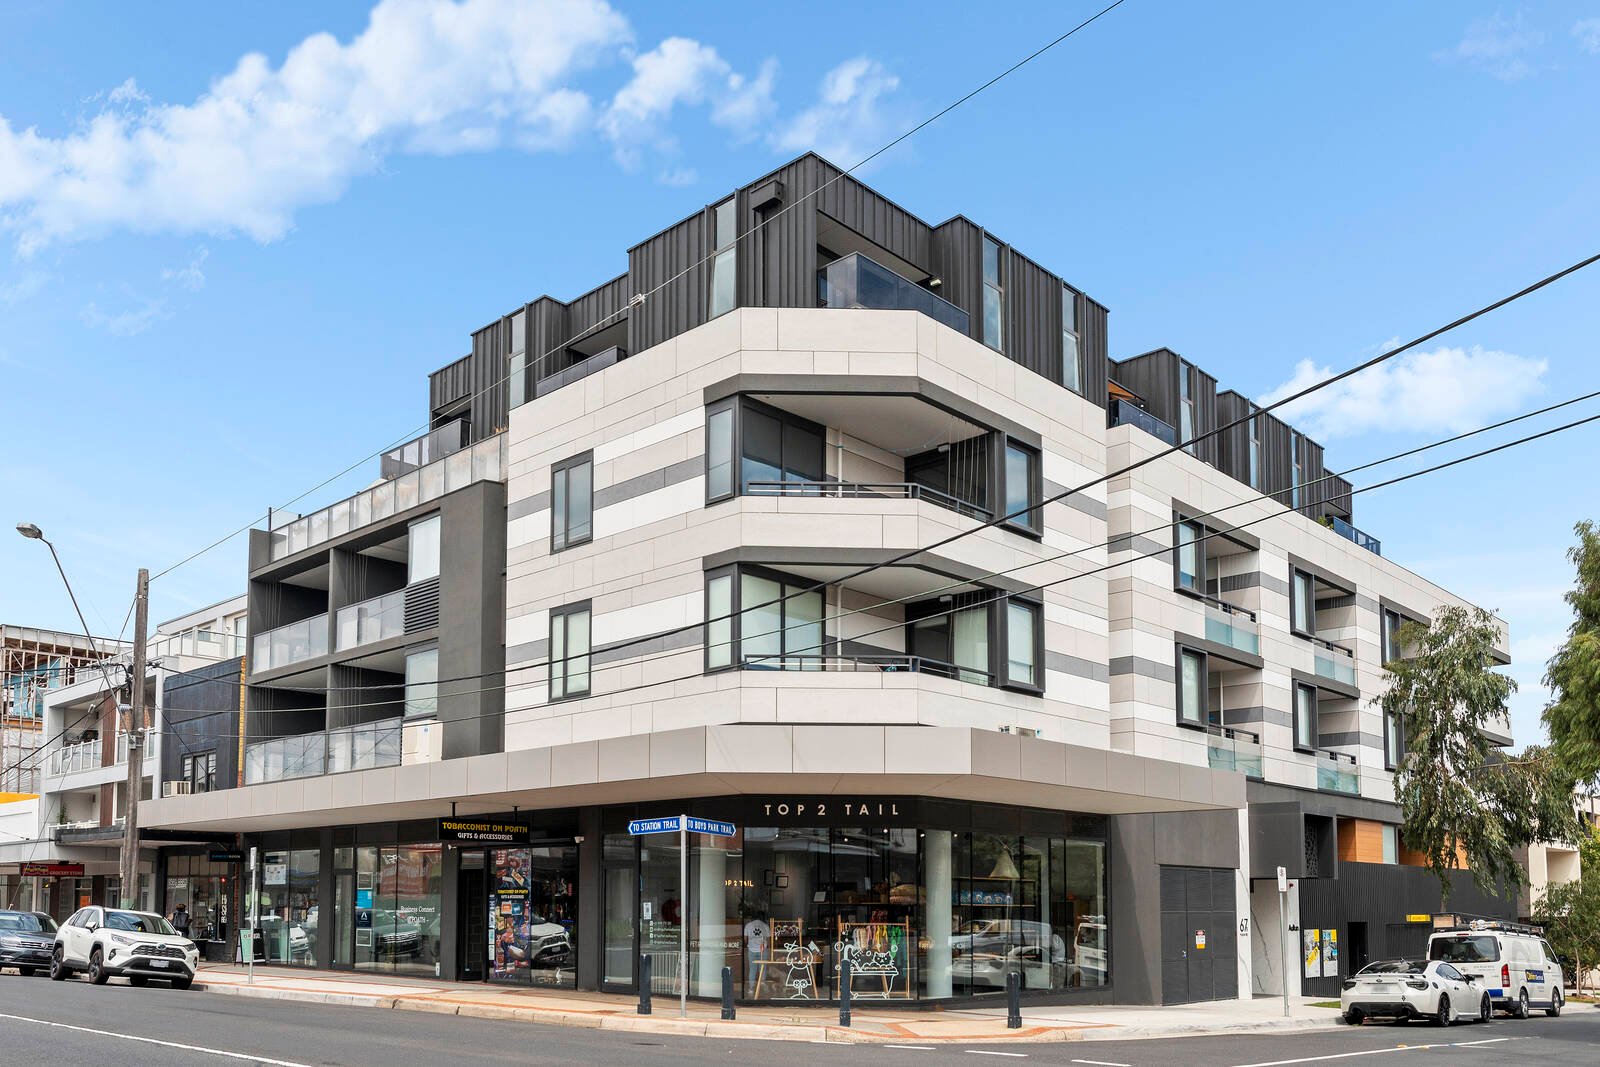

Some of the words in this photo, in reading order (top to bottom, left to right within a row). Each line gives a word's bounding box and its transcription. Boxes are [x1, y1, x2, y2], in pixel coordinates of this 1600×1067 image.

[764, 804, 805, 816] TOP
[817, 804, 826, 816] 2
[845, 804, 899, 816] TAIL
[442, 822, 491, 832] TOBACCONIST
[492, 824, 503, 832] ON
[504, 825, 528, 833] POATH
[632, 823, 640, 832] TO
[641, 820, 661, 831] STATION
[663, 819, 679, 830] TRAIL
[695, 820, 707, 831] BOYD
[708, 822, 719, 832] PARK
[720, 824, 733, 834] TRAIL
[479, 833, 513, 841] ACCESSORIES
[400, 905, 418, 913] Business
[418, 905, 435, 913] Connect
